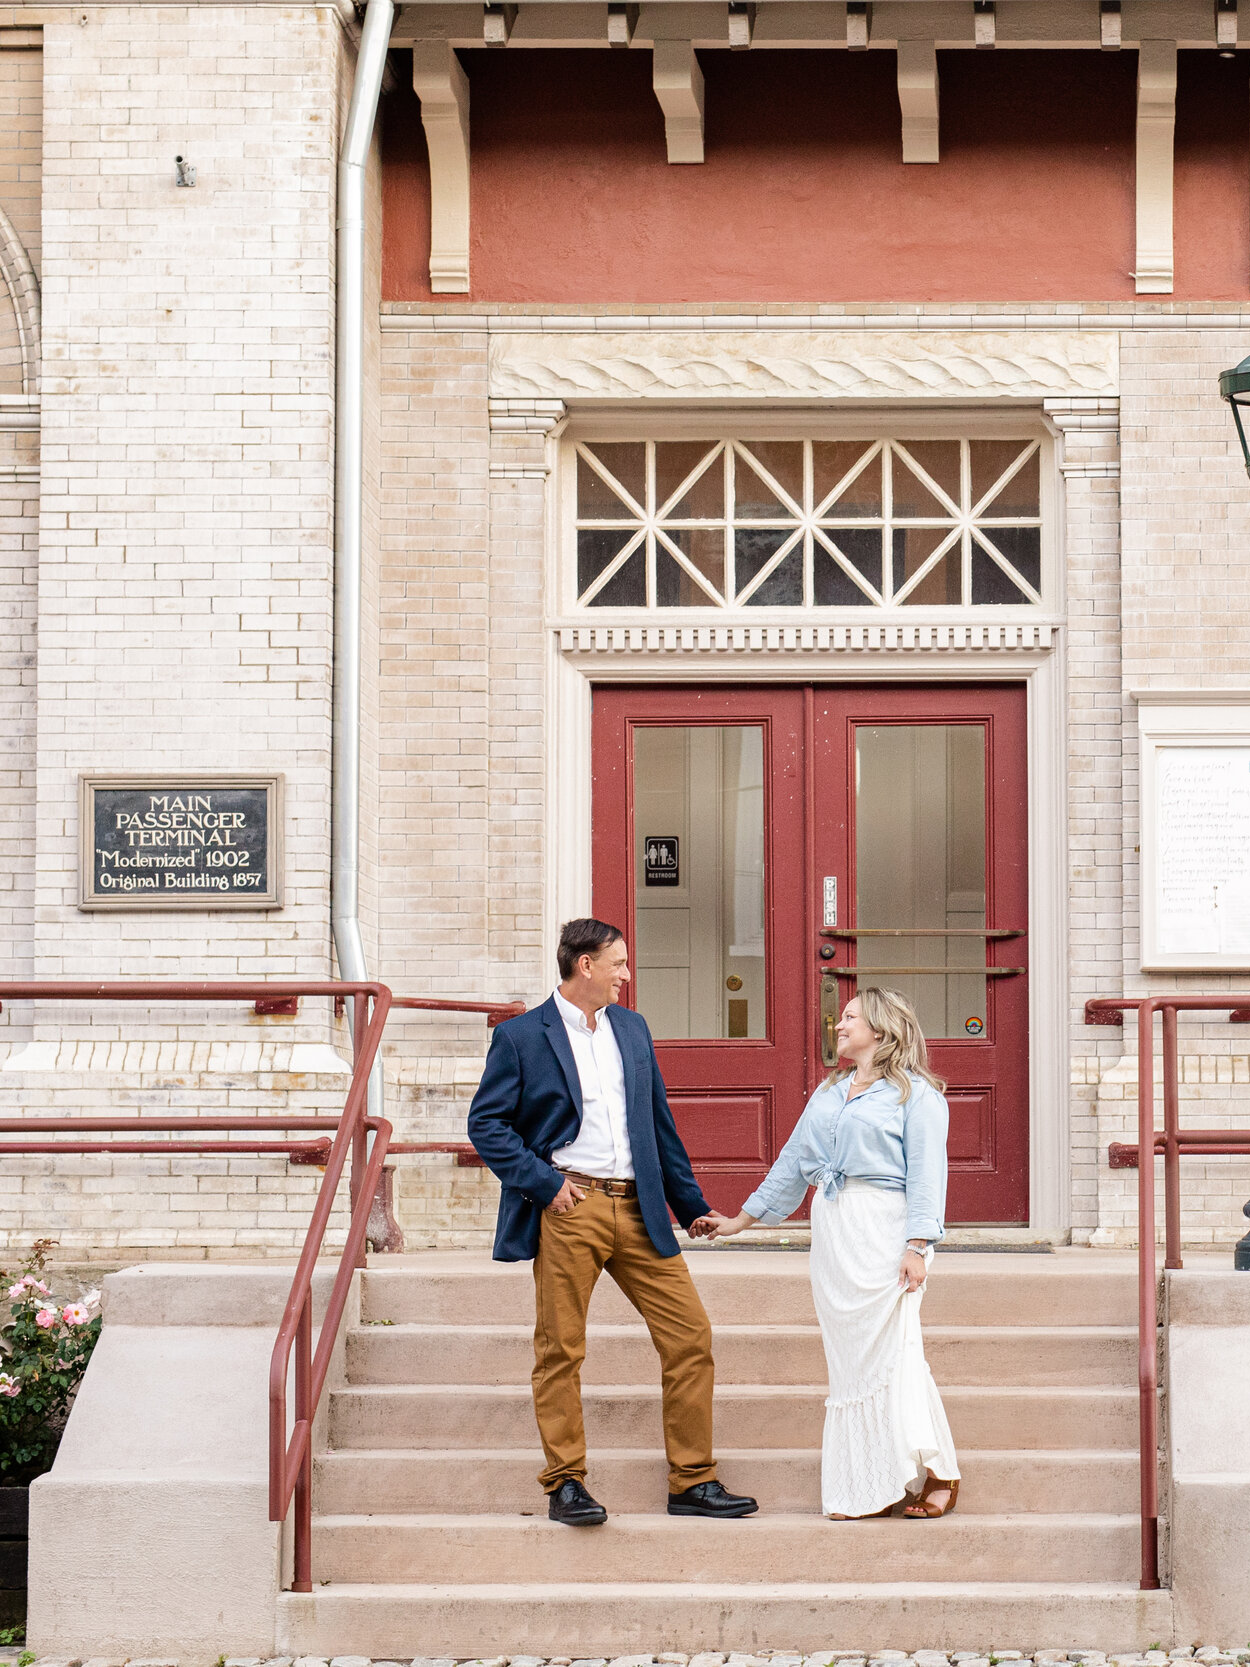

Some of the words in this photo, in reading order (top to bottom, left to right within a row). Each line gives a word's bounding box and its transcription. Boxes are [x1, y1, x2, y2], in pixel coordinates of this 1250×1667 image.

[150, 796, 211, 812] MAIN
[116, 812, 246, 829] PASSENGER
[125, 829, 236, 847] TERMINAL
[206, 851, 250, 867] 1902
[100, 873, 159, 890] Original
[165, 873, 230, 890] Building
[233, 873, 262, 887] 1857
[825, 878, 836, 925] PUSH
